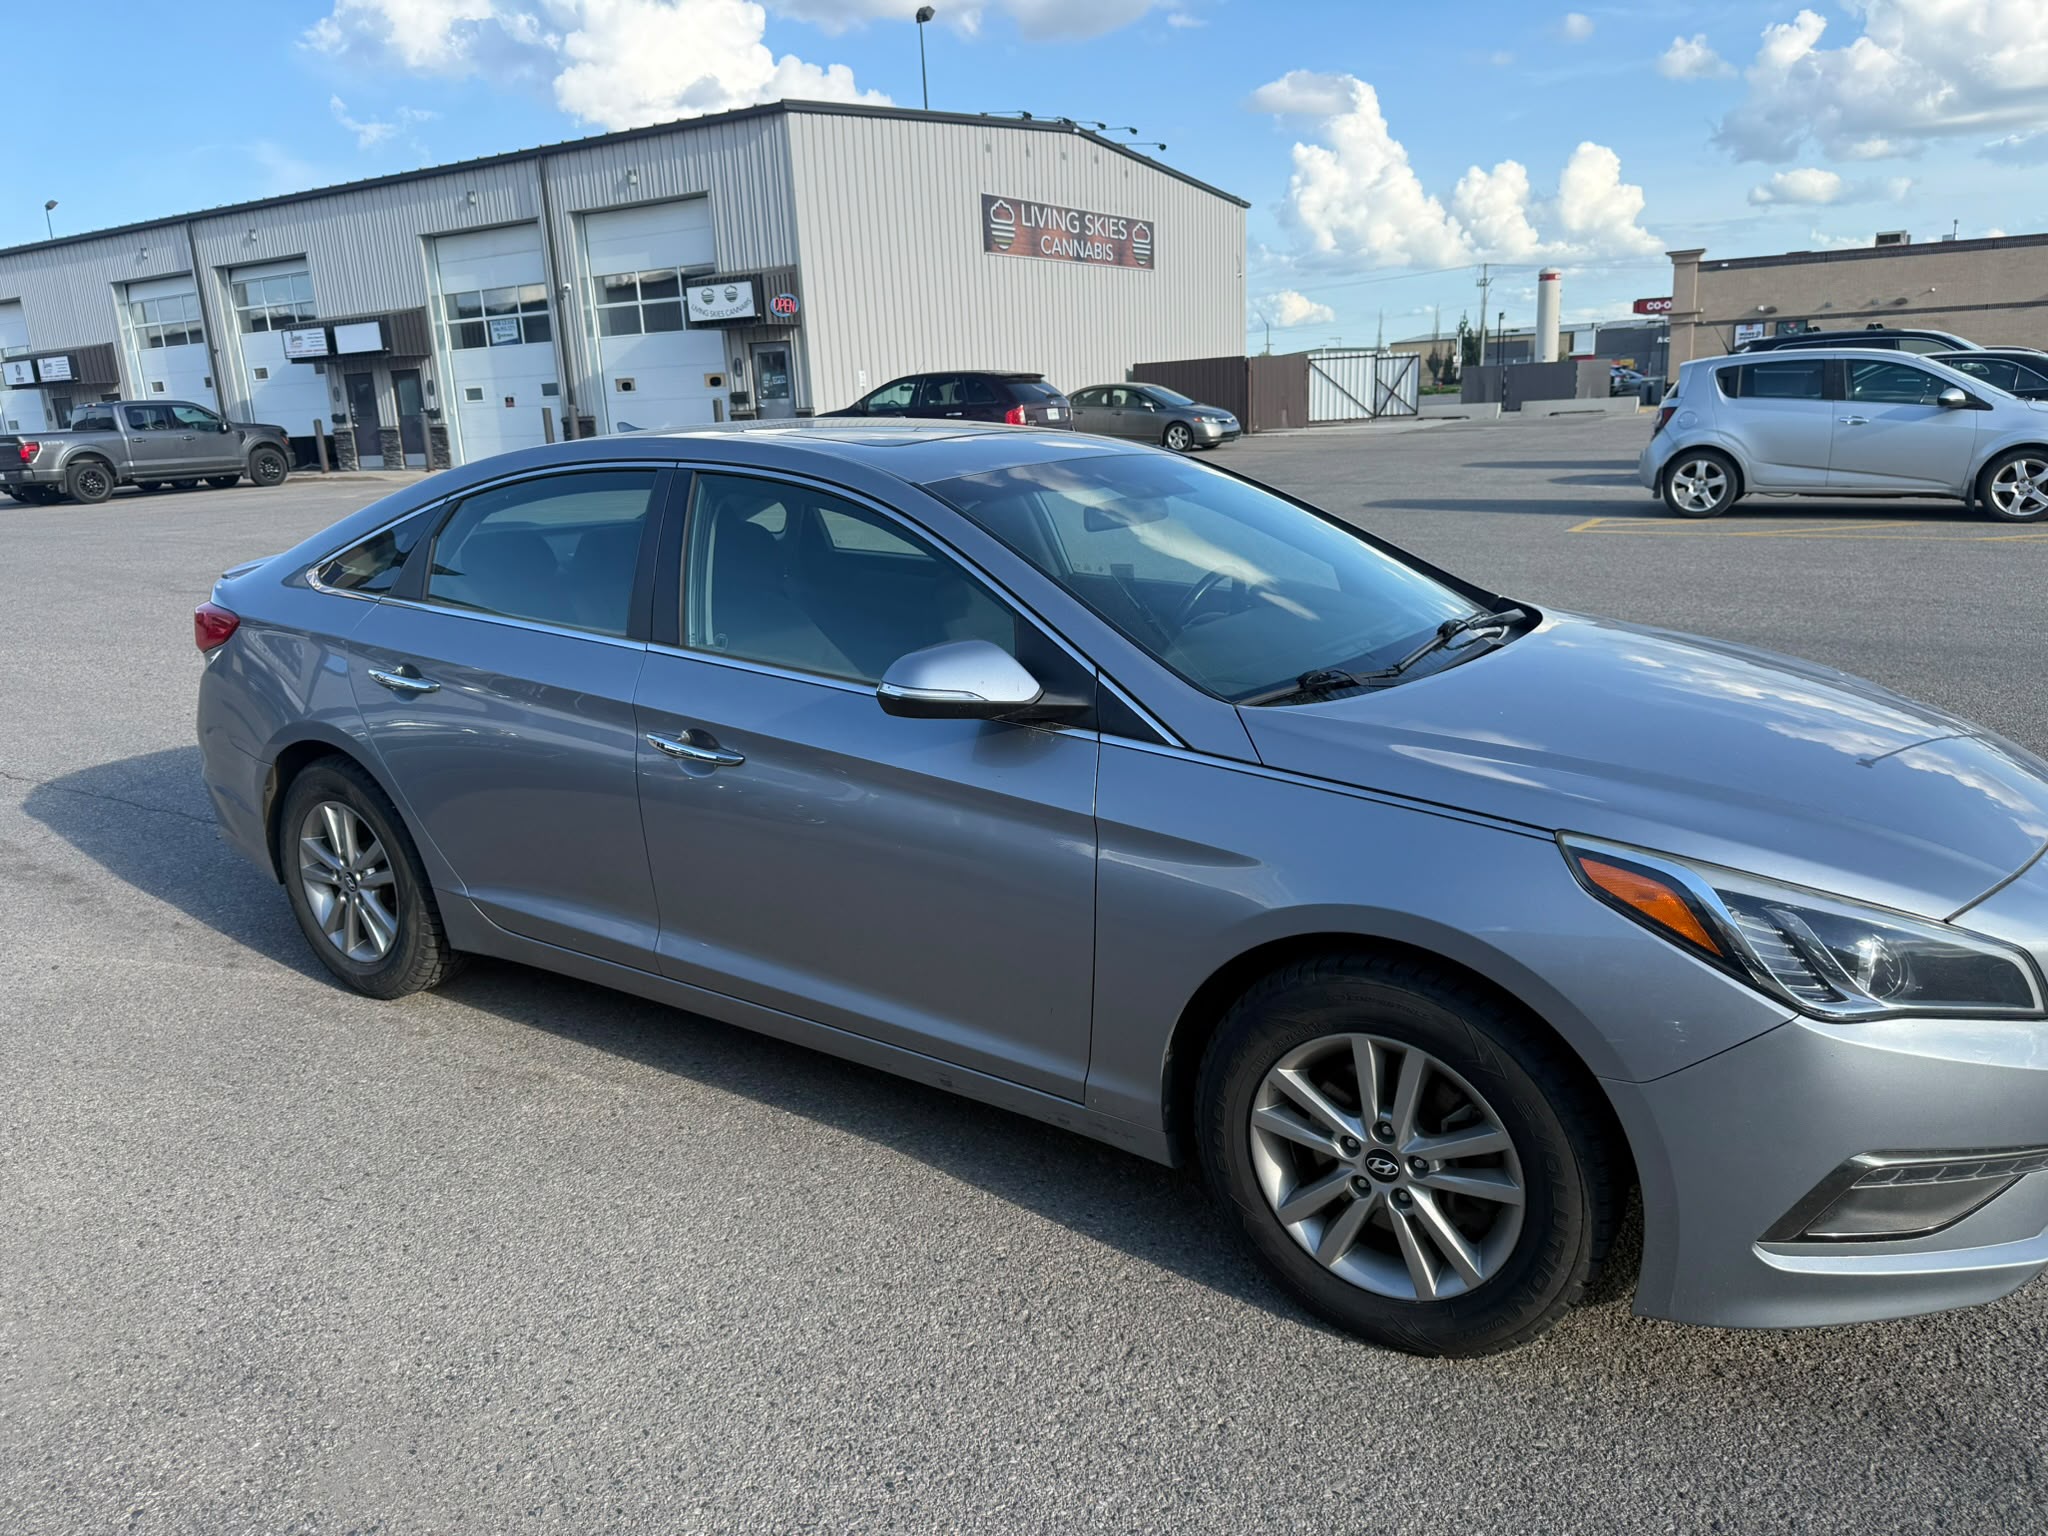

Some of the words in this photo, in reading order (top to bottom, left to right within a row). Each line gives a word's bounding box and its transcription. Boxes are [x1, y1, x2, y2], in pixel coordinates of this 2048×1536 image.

[1021, 203, 1080, 233] LIVING
[1084, 214, 1128, 240] SKIES
[1040, 235, 1114, 262] CANNABIS
[774, 297, 797, 313] OPEN
